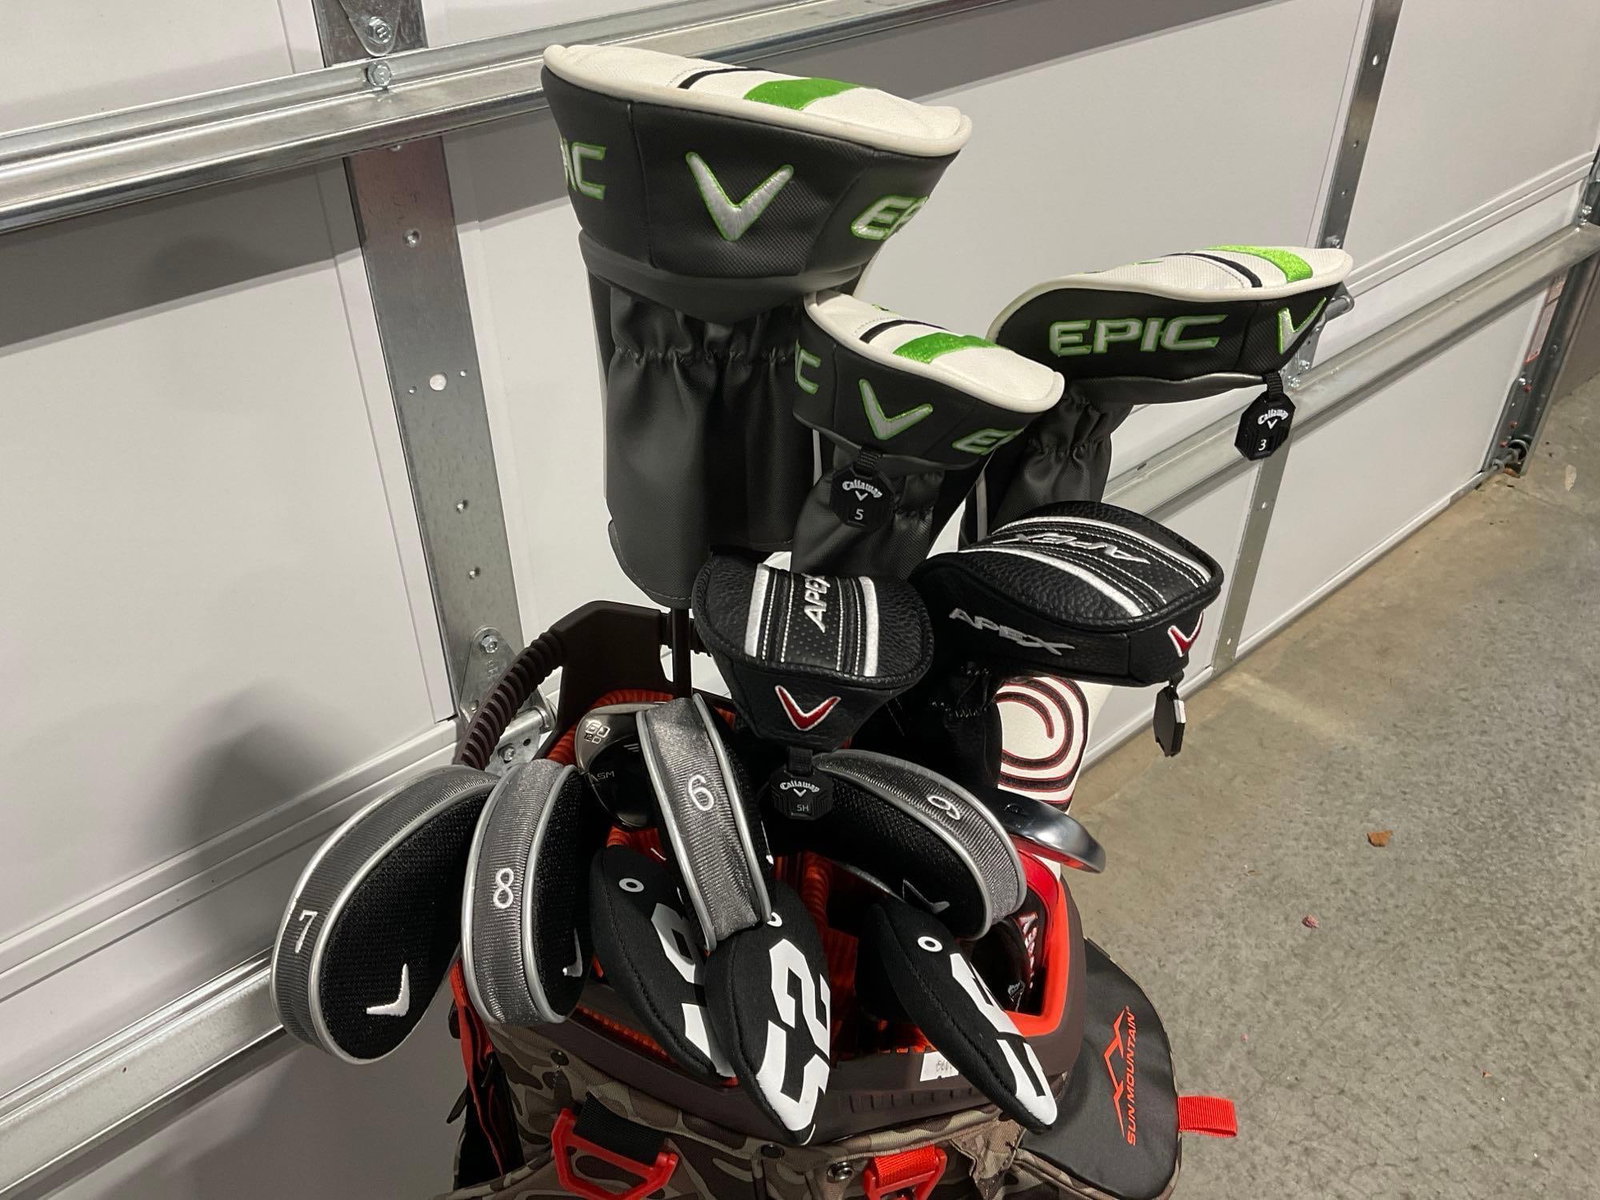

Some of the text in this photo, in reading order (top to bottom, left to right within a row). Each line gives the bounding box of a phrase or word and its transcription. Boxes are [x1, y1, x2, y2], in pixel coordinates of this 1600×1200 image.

[1049, 314, 1229, 357] EPIC
[1258, 439, 1267, 451] 3
[842, 479, 883, 498] Callaway
[854, 508, 864, 521] 5
[949, 608, 1076, 656] APEX
[687, 774, 715, 812] 6
[780, 780, 820, 793] Callaway
[493, 868, 514, 909] 8
[295, 910, 318, 953] 7
[1125, 1011, 1137, 1146] SUN MOUNTAIN
